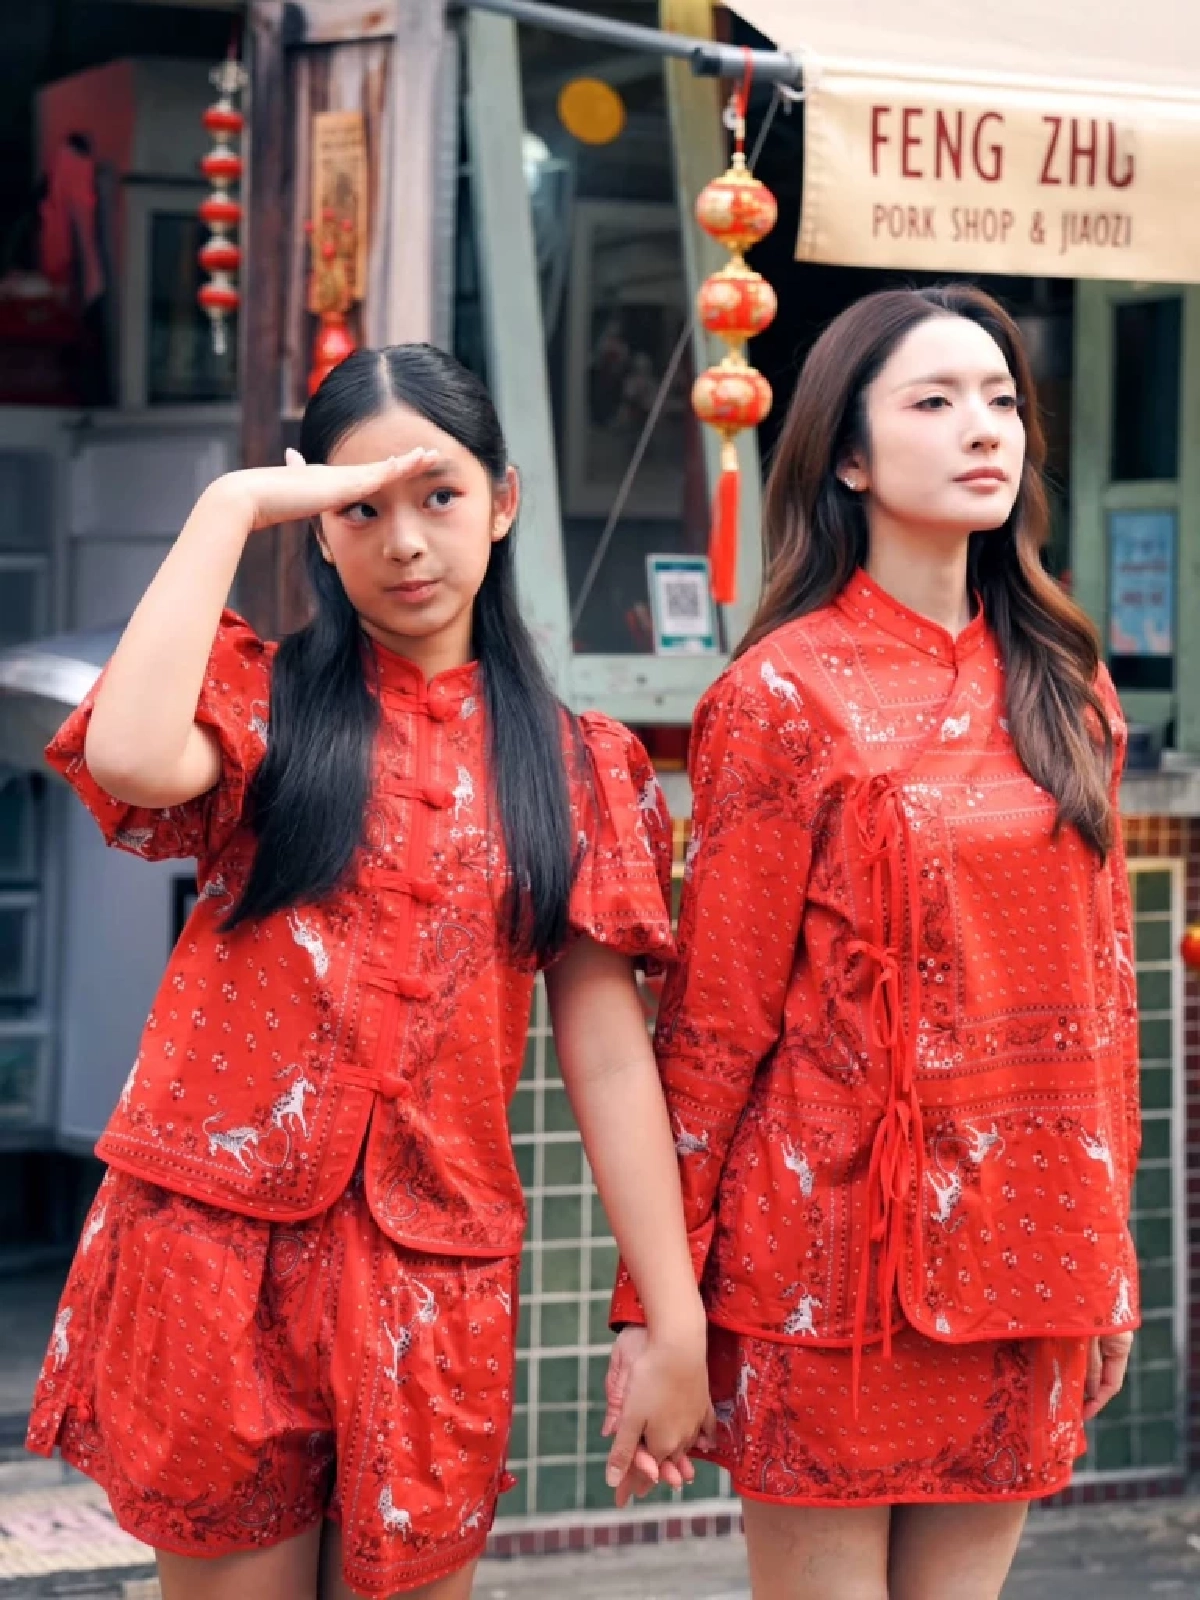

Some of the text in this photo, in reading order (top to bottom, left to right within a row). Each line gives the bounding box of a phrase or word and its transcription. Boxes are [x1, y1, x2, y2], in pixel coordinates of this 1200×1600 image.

[870, 105, 1005, 182] FENG
[872, 203, 1132, 255] PORK SHOP & JIAOZI
